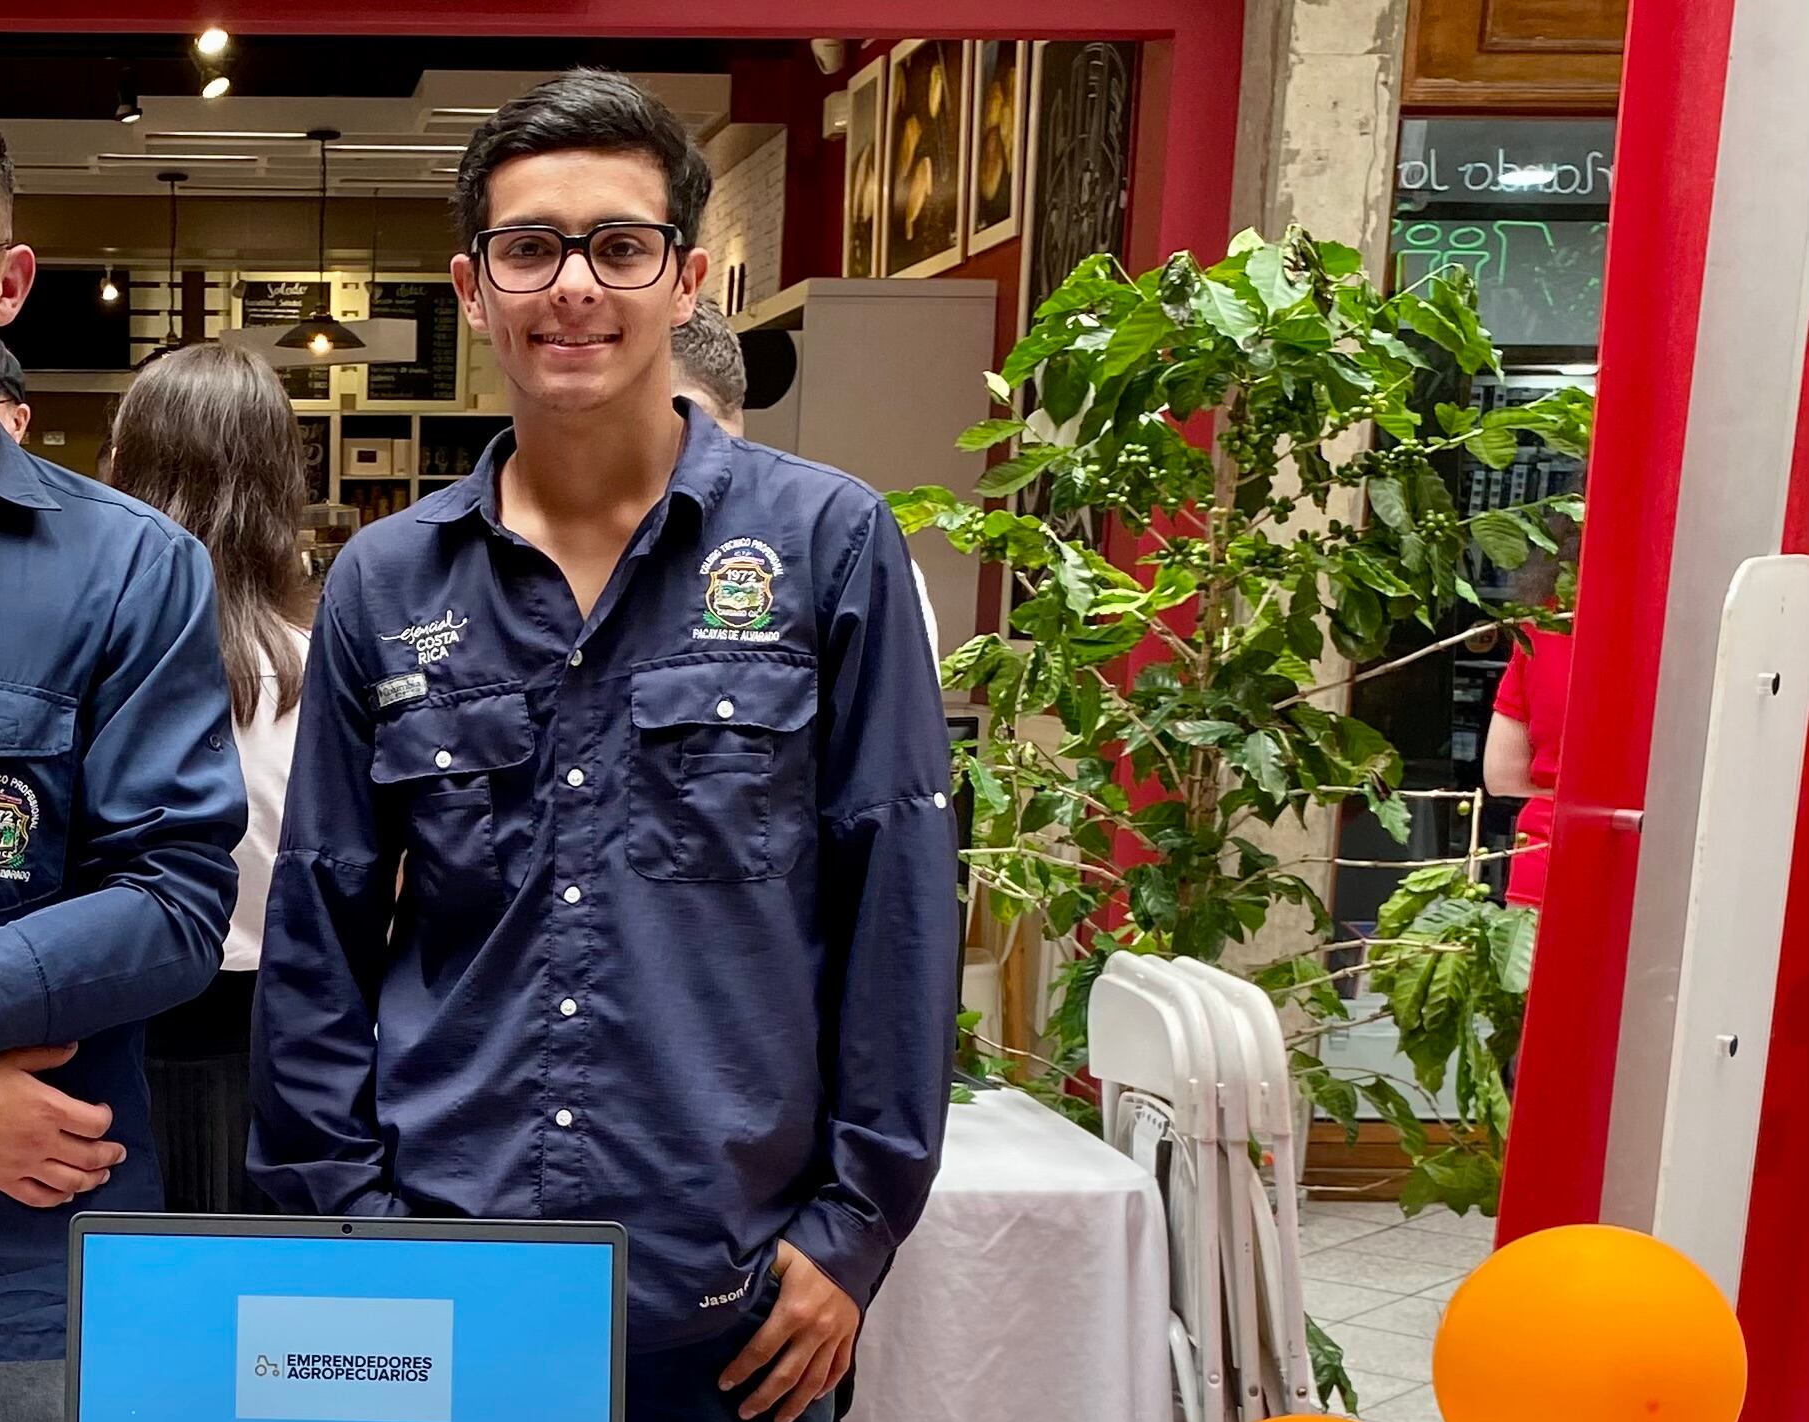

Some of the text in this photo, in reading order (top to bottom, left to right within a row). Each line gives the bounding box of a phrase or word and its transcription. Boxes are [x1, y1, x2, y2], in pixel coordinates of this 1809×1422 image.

[726, 569, 757, 582] 1972
[416, 630, 460, 652] COSTA
[728, 630, 740, 641] DE
[740, 630, 780, 642] ALVARADO
[418, 645, 450, 665] RICA
[699, 1287, 744, 1308] Jason
[287, 1354, 433, 1369] EMPRENDEDORES
[287, 1366, 429, 1382] AGROPECUARIOS
